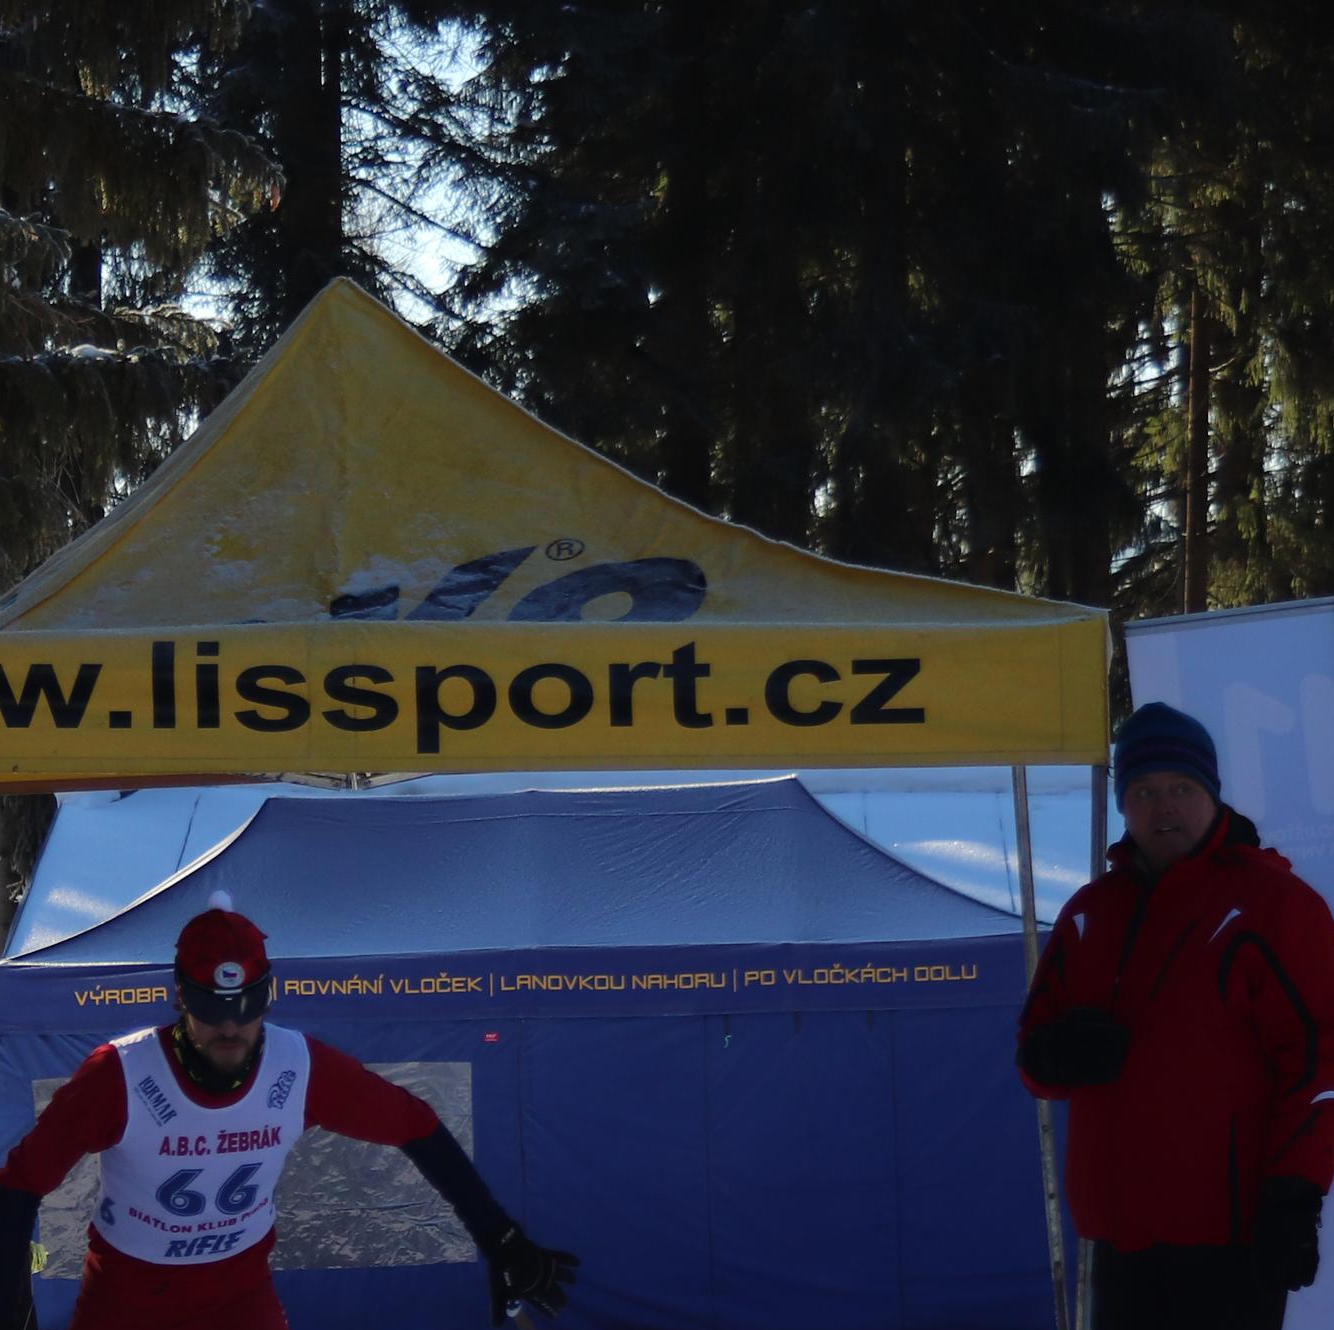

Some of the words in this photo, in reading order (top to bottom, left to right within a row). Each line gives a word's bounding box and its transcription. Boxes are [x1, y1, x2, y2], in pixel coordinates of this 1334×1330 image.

[284, 975, 385, 996] ROVNÁNÍ
[390, 970, 483, 994] VLOČEK
[500, 974, 626, 992] LANOVKOU
[632, 972, 726, 990] NAHORU
[744, 970, 776, 987] PO
[783, 963, 908, 985] VLOČKÁCH
[914, 964, 979, 981] DOLU
[74, 984, 168, 1006] VÝROBA
[158, 1136, 212, 1156] A.B.C.
[217, 1125, 282, 1155] ŽEBRÁK
[155, 1162, 263, 1217] 66
[128, 1207, 192, 1233] BIATLON
[197, 1217, 237, 1232] KLUB
